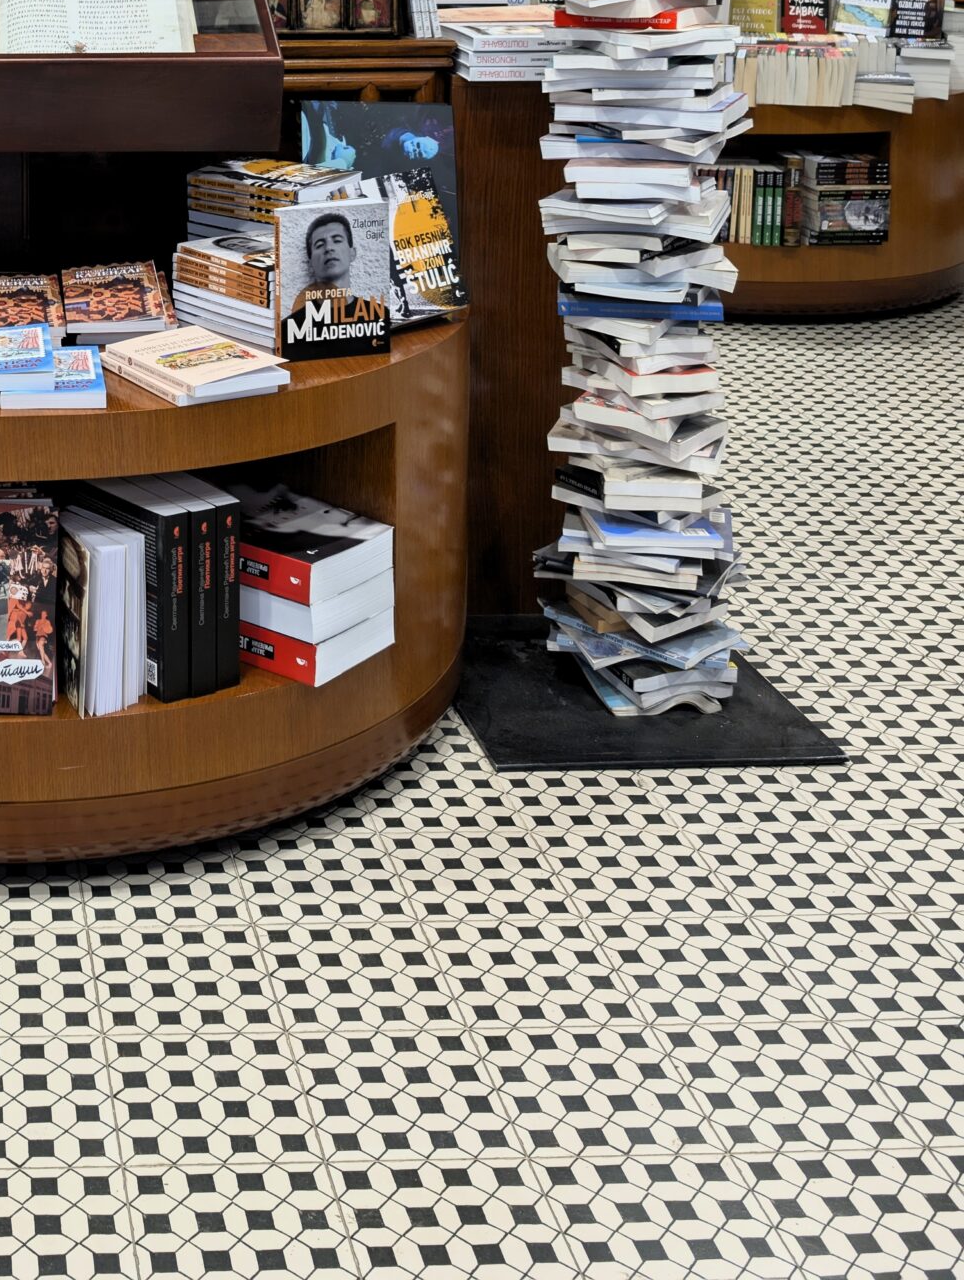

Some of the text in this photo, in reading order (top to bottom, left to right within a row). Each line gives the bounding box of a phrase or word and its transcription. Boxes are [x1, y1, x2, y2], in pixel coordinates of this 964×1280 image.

[789, 6, 824, 17] ZABAVE
[898, 1, 925, 10] OZBILJNO?
[352, 218, 385, 229] Zlatomir
[365, 229, 385, 241] Gajić
[394, 236, 414, 251] ROK
[397, 239, 452, 265] BRANIMIR
[405, 258, 459, 294] ŠTULIĆ
[305, 287, 352, 300] ROK POETA
[304, 295, 385, 324] MILAN
[286, 318, 385, 344] MLADENOVIĆ
